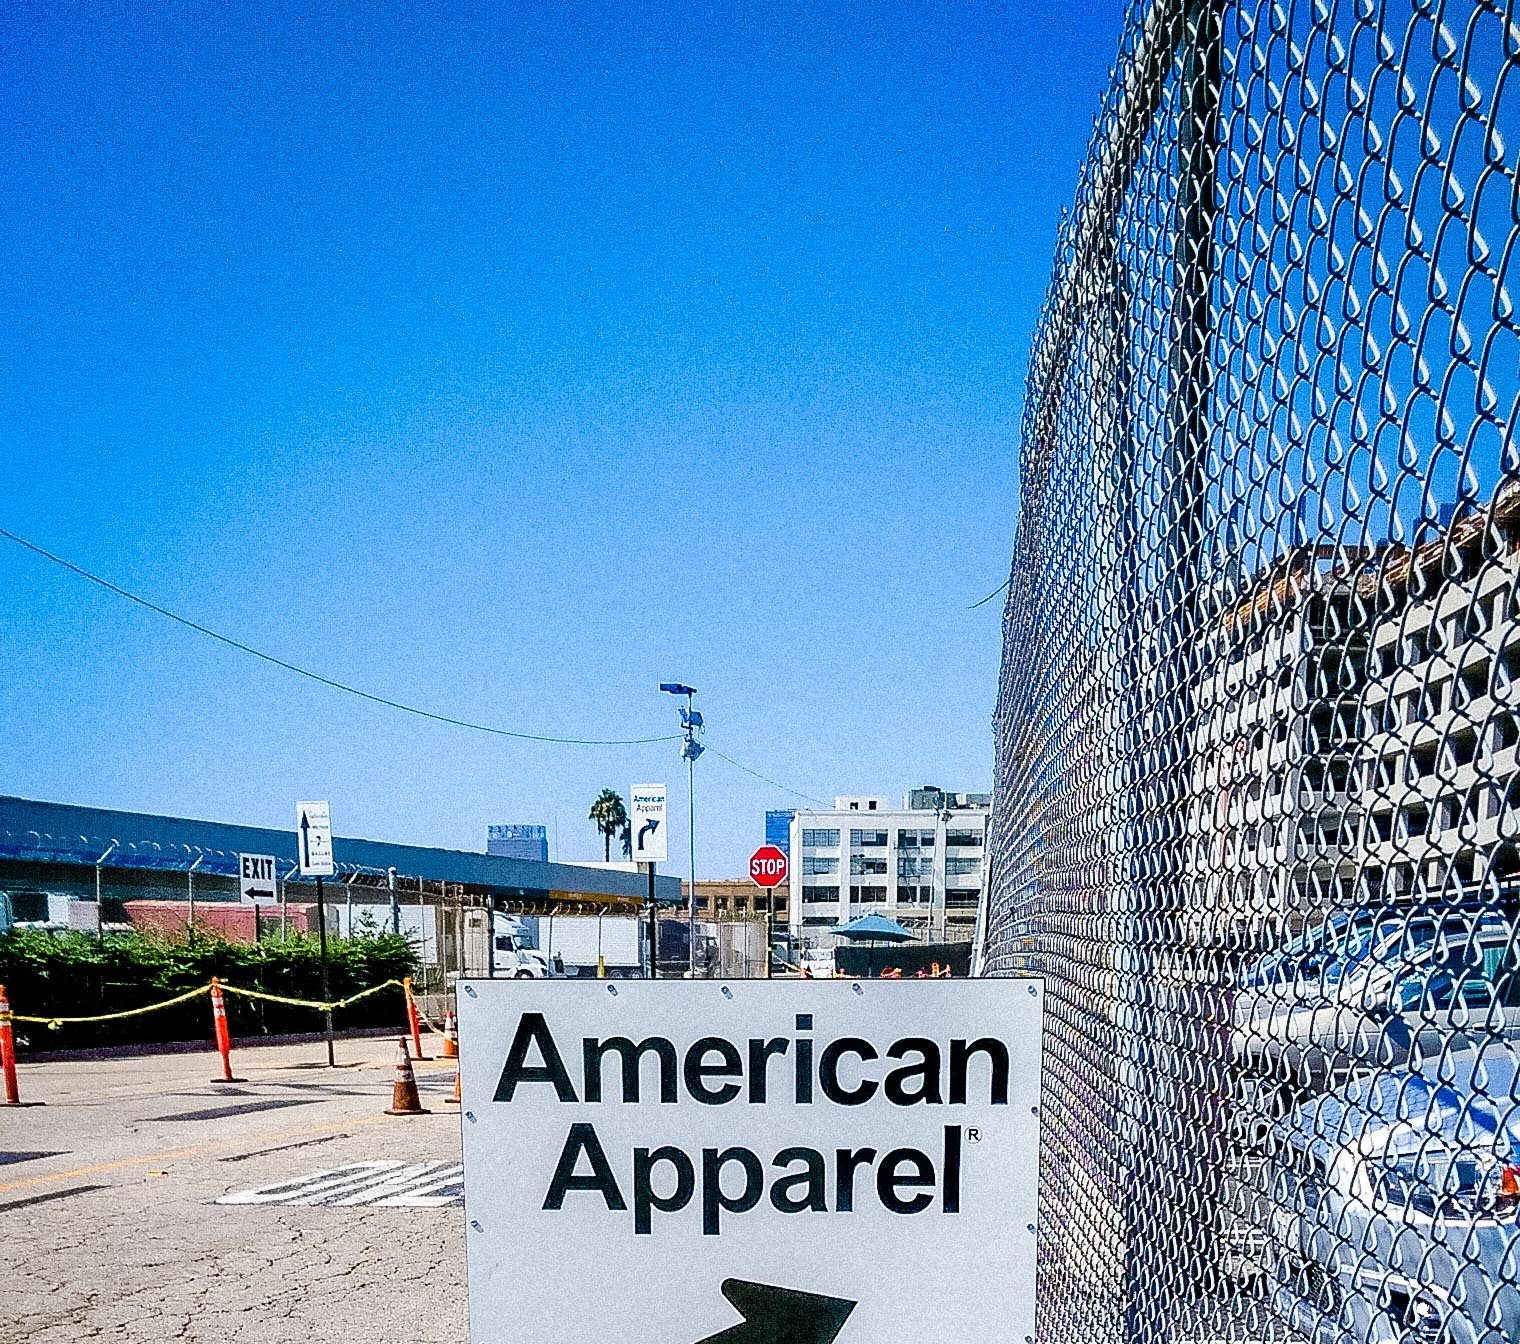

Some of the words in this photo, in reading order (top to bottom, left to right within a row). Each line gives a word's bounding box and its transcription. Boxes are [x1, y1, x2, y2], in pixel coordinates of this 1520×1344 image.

[634, 795, 665, 803] American
[242, 856, 273, 880] EXIT
[751, 858, 785, 876] STOP
[493, 1012, 1010, 1106] American
